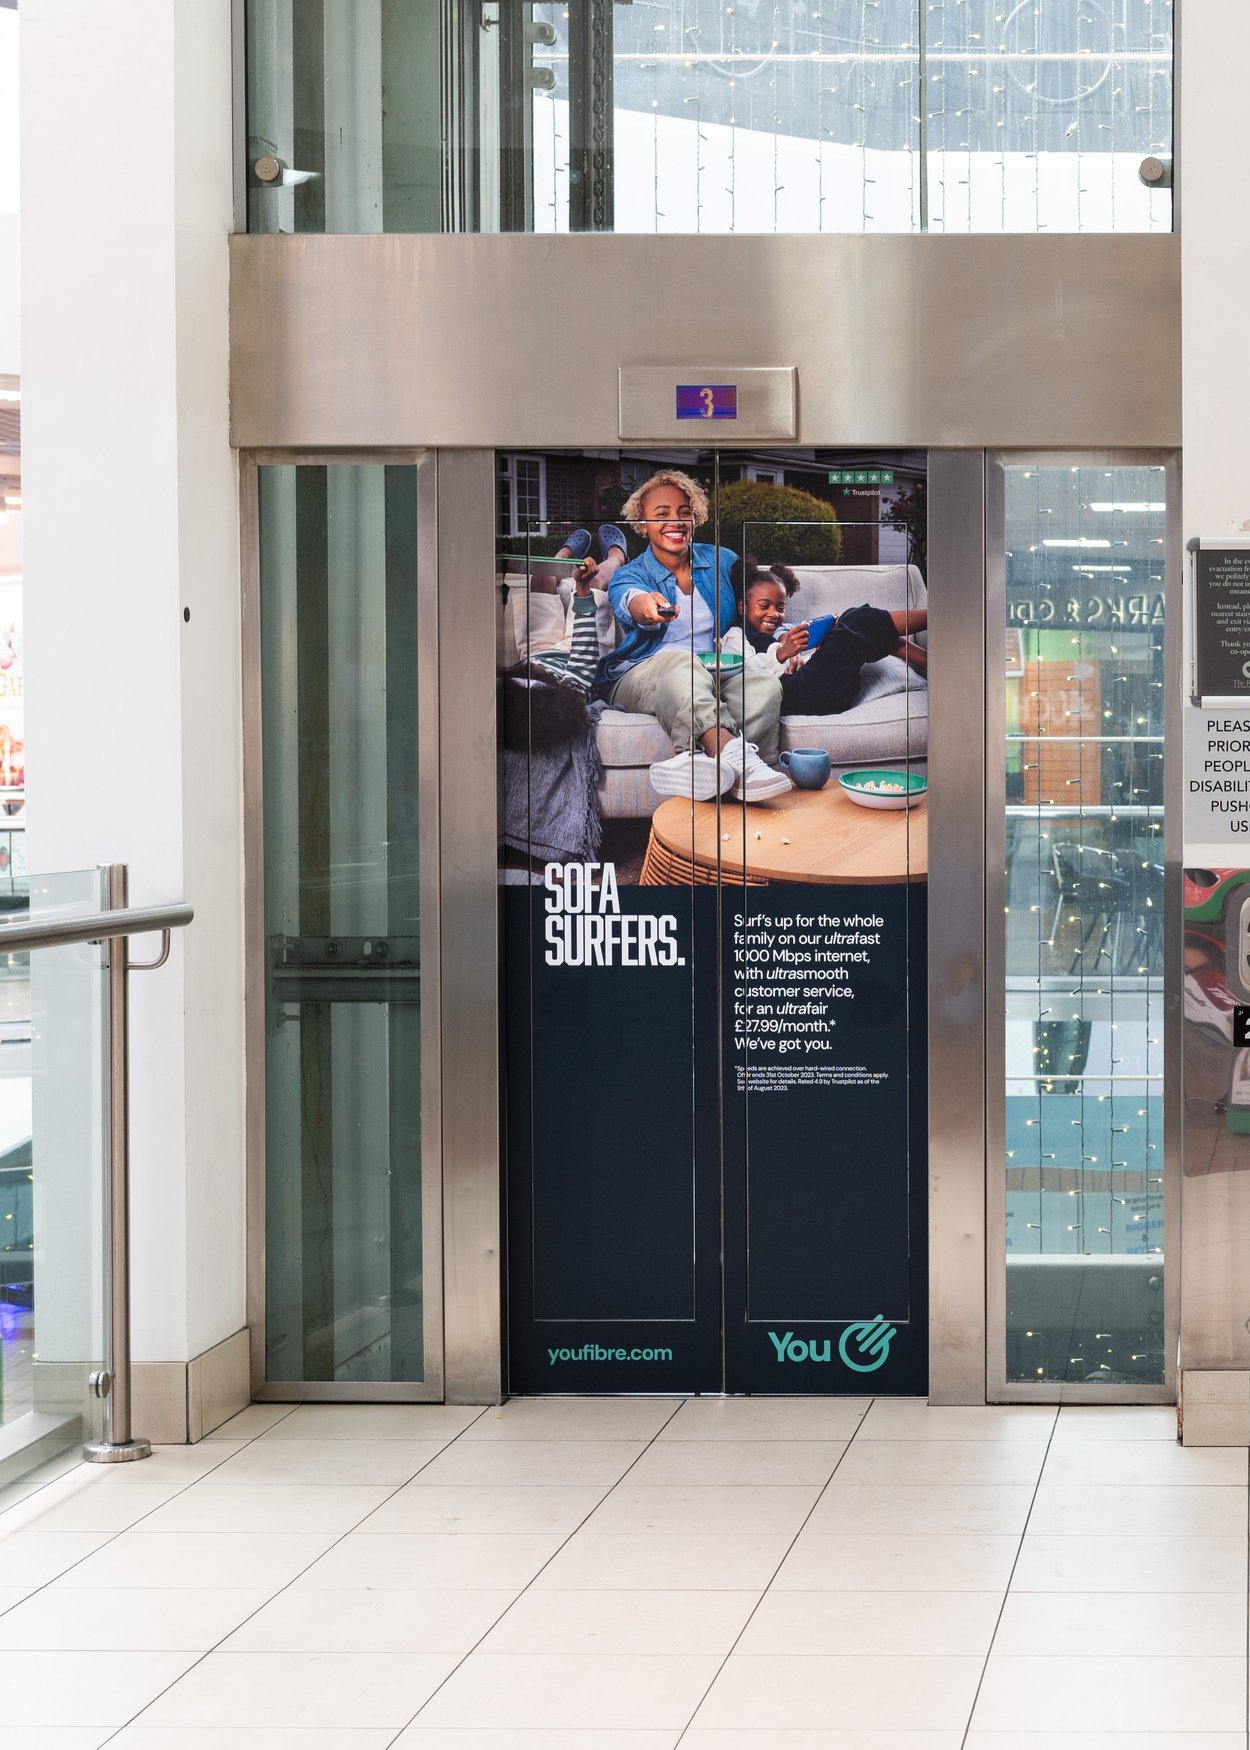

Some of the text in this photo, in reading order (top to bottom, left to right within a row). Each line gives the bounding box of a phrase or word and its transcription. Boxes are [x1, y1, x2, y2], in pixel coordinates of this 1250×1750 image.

[700, 388, 714, 418] 3
[1226, 572, 1249, 581] politely
[1217, 602, 1241, 612] Instead,
[545, 862, 620, 913] SOFA
[734, 914, 884, 930] Surf's up for the whole
[545, 915, 686, 966] SURFERS.
[734, 931, 880, 948] family on our ultrafast
[734, 949, 870, 965] 1000 Mbps internet,
[734, 967, 848, 980] with ultrasmooth
[734, 984, 854, 999] customer service,
[734, 1002, 828, 1015] for an ultrafair
[734, 1037, 832, 1053] We've got you.
[548, 1344, 672, 1365] youfibre.com
[768, 1332, 831, 1362] You
